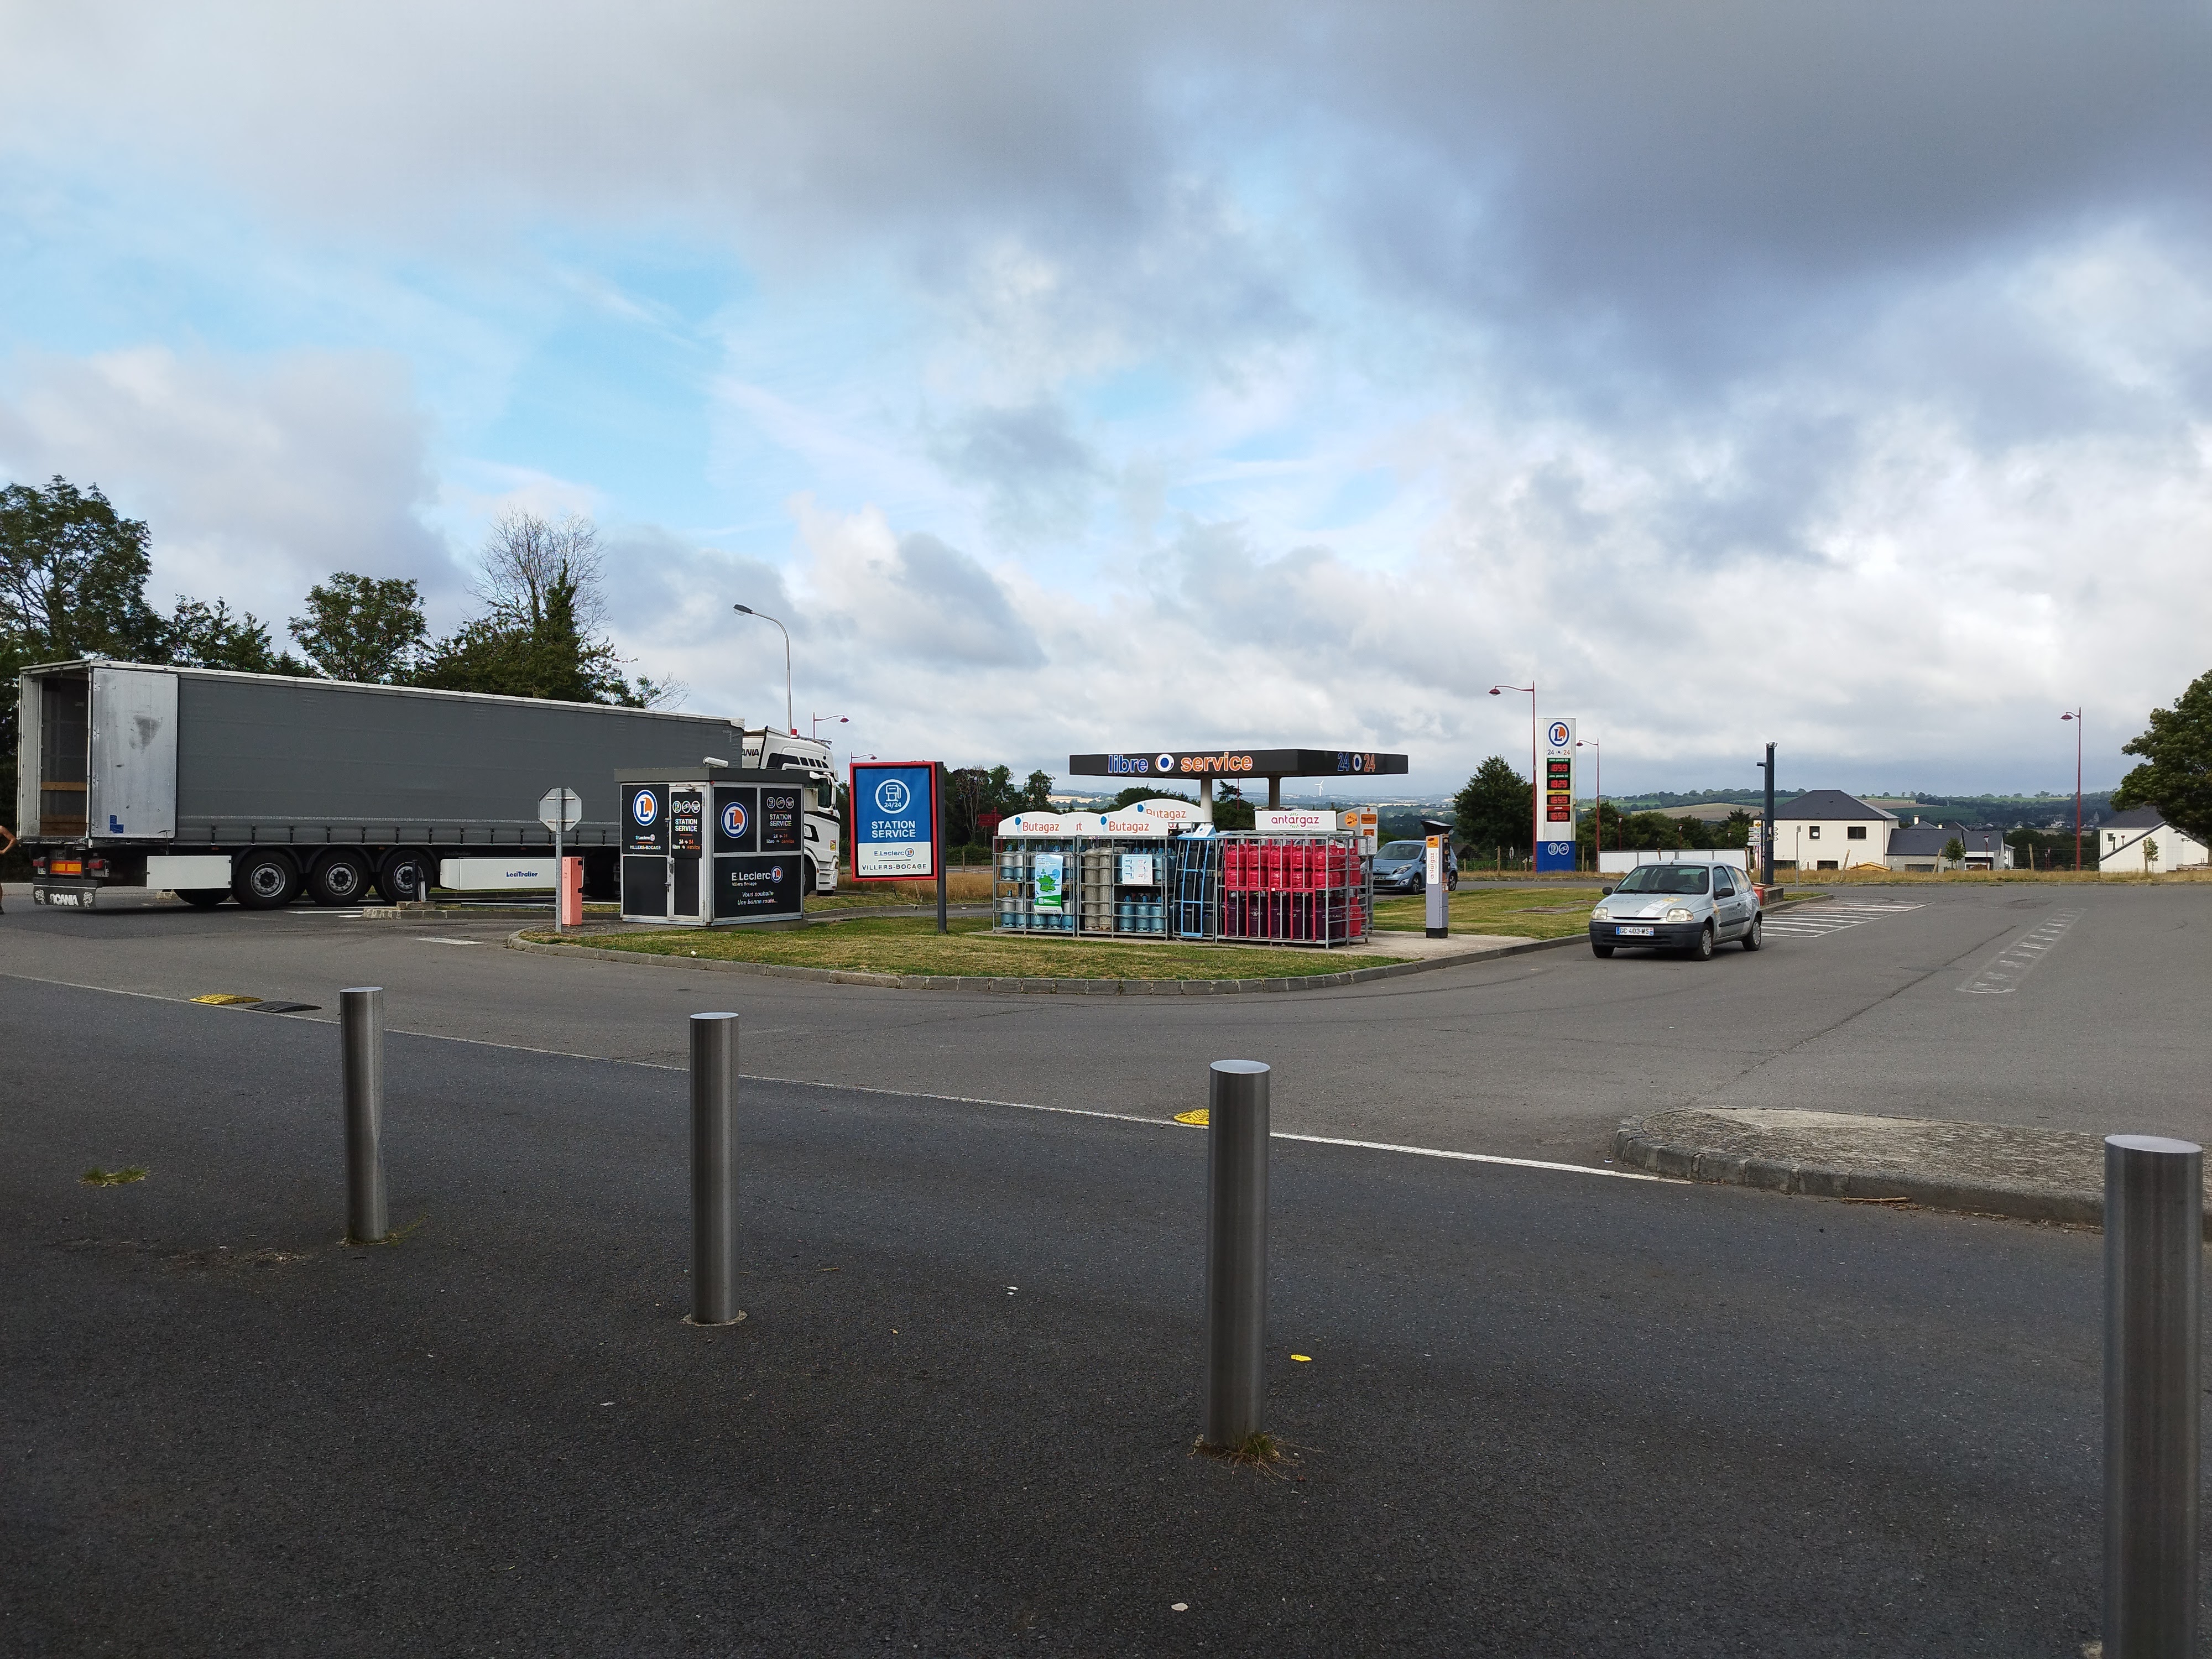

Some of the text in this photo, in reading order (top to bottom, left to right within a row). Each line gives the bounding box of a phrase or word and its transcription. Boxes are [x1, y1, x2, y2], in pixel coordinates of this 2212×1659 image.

[742, 748, 759, 757] ANIA
[1108, 752, 1253, 773] libre service
[1337, 752, 1375, 772] 24 24
[871, 820, 915, 830] STATION
[1022, 821, 1060, 833] Butagaz
[1109, 821, 1149, 833] Butagaz
[1271, 815, 1319, 827] antargaz
[871, 829, 916, 838] SERVICE
